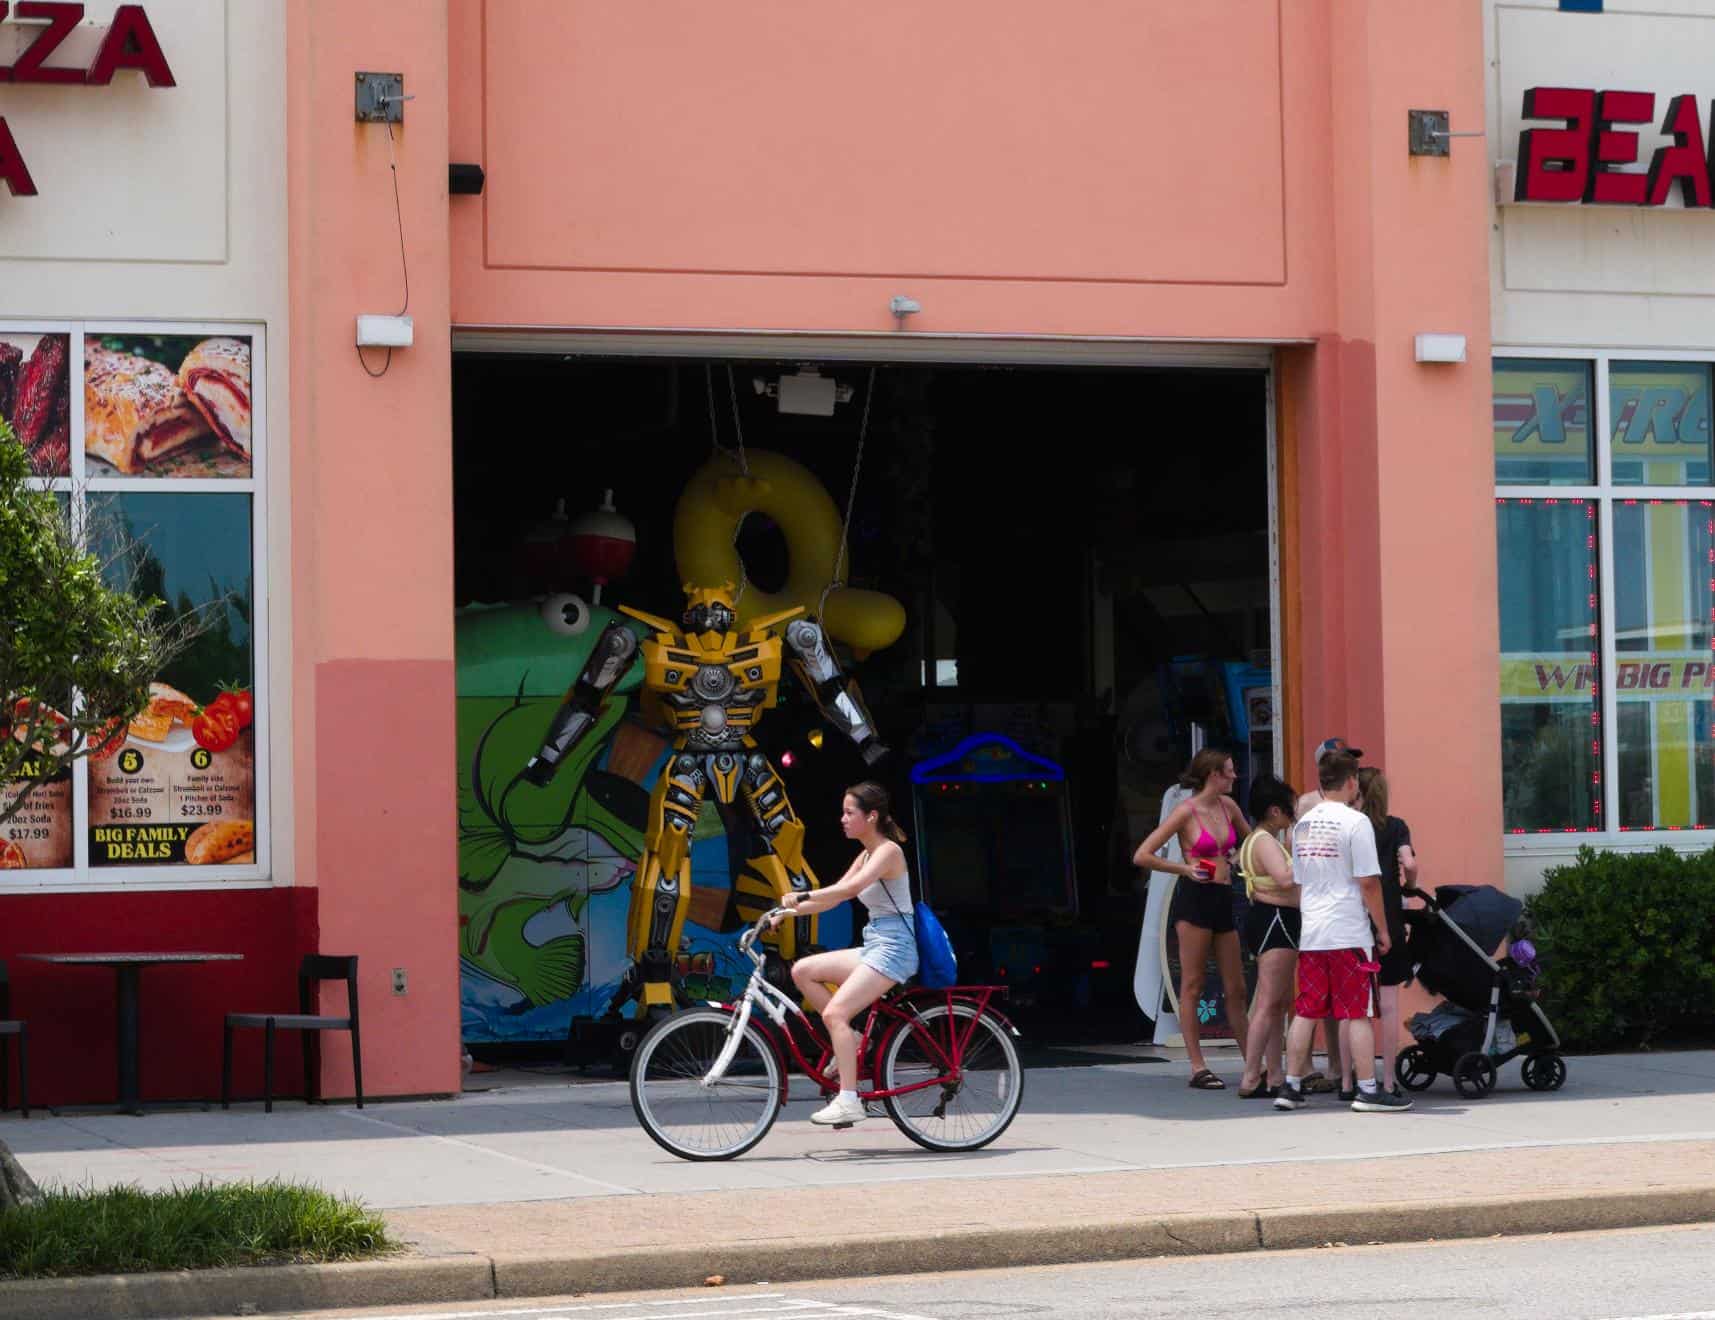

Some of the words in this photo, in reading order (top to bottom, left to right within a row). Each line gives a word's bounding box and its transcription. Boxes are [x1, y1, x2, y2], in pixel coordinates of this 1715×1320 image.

[0, 1, 176, 88] ZA
[1514, 87, 1715, 208] BEA
[1616, 663, 1671, 689] BIG
[123, 751, 138, 771] 5
[194, 750, 208, 767] 6
[110, 807, 152, 819] $16.99
[181, 805, 223, 816] $23.99
[30, 815, 52, 824] Soda
[9, 828, 49, 840] $17.99
[95, 828, 123, 842] BIG
[126, 827, 189, 842] FAMILY
[107, 842, 172, 859] DEALS
